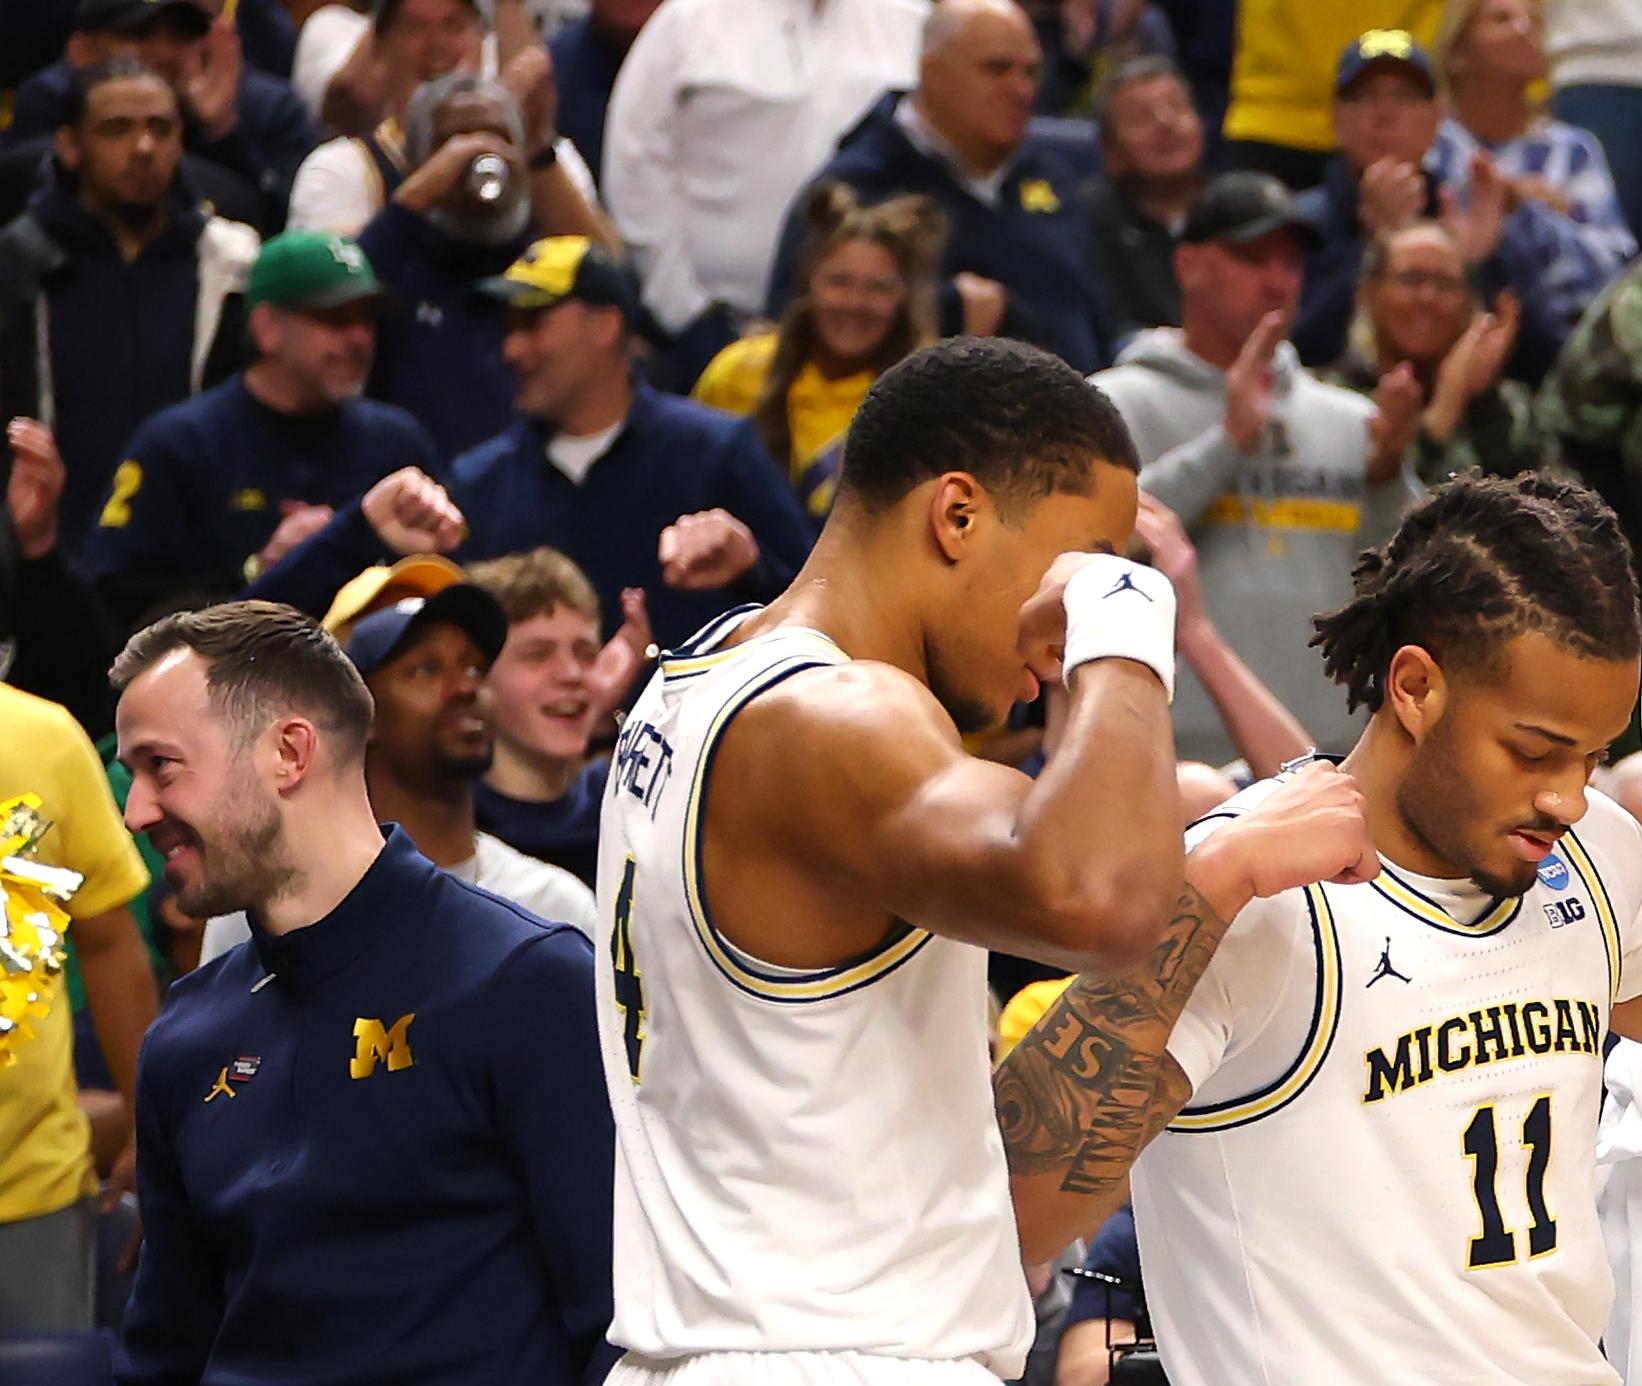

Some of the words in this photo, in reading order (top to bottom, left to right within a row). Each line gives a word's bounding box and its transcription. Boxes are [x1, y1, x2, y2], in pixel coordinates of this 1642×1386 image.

[99, 459, 143, 529] 2
[610, 851, 649, 1086] 4
[350, 1013, 416, 1080] M
[1361, 997, 1600, 1105] MICHIGAN
[1460, 1092, 1558, 1271] 11
